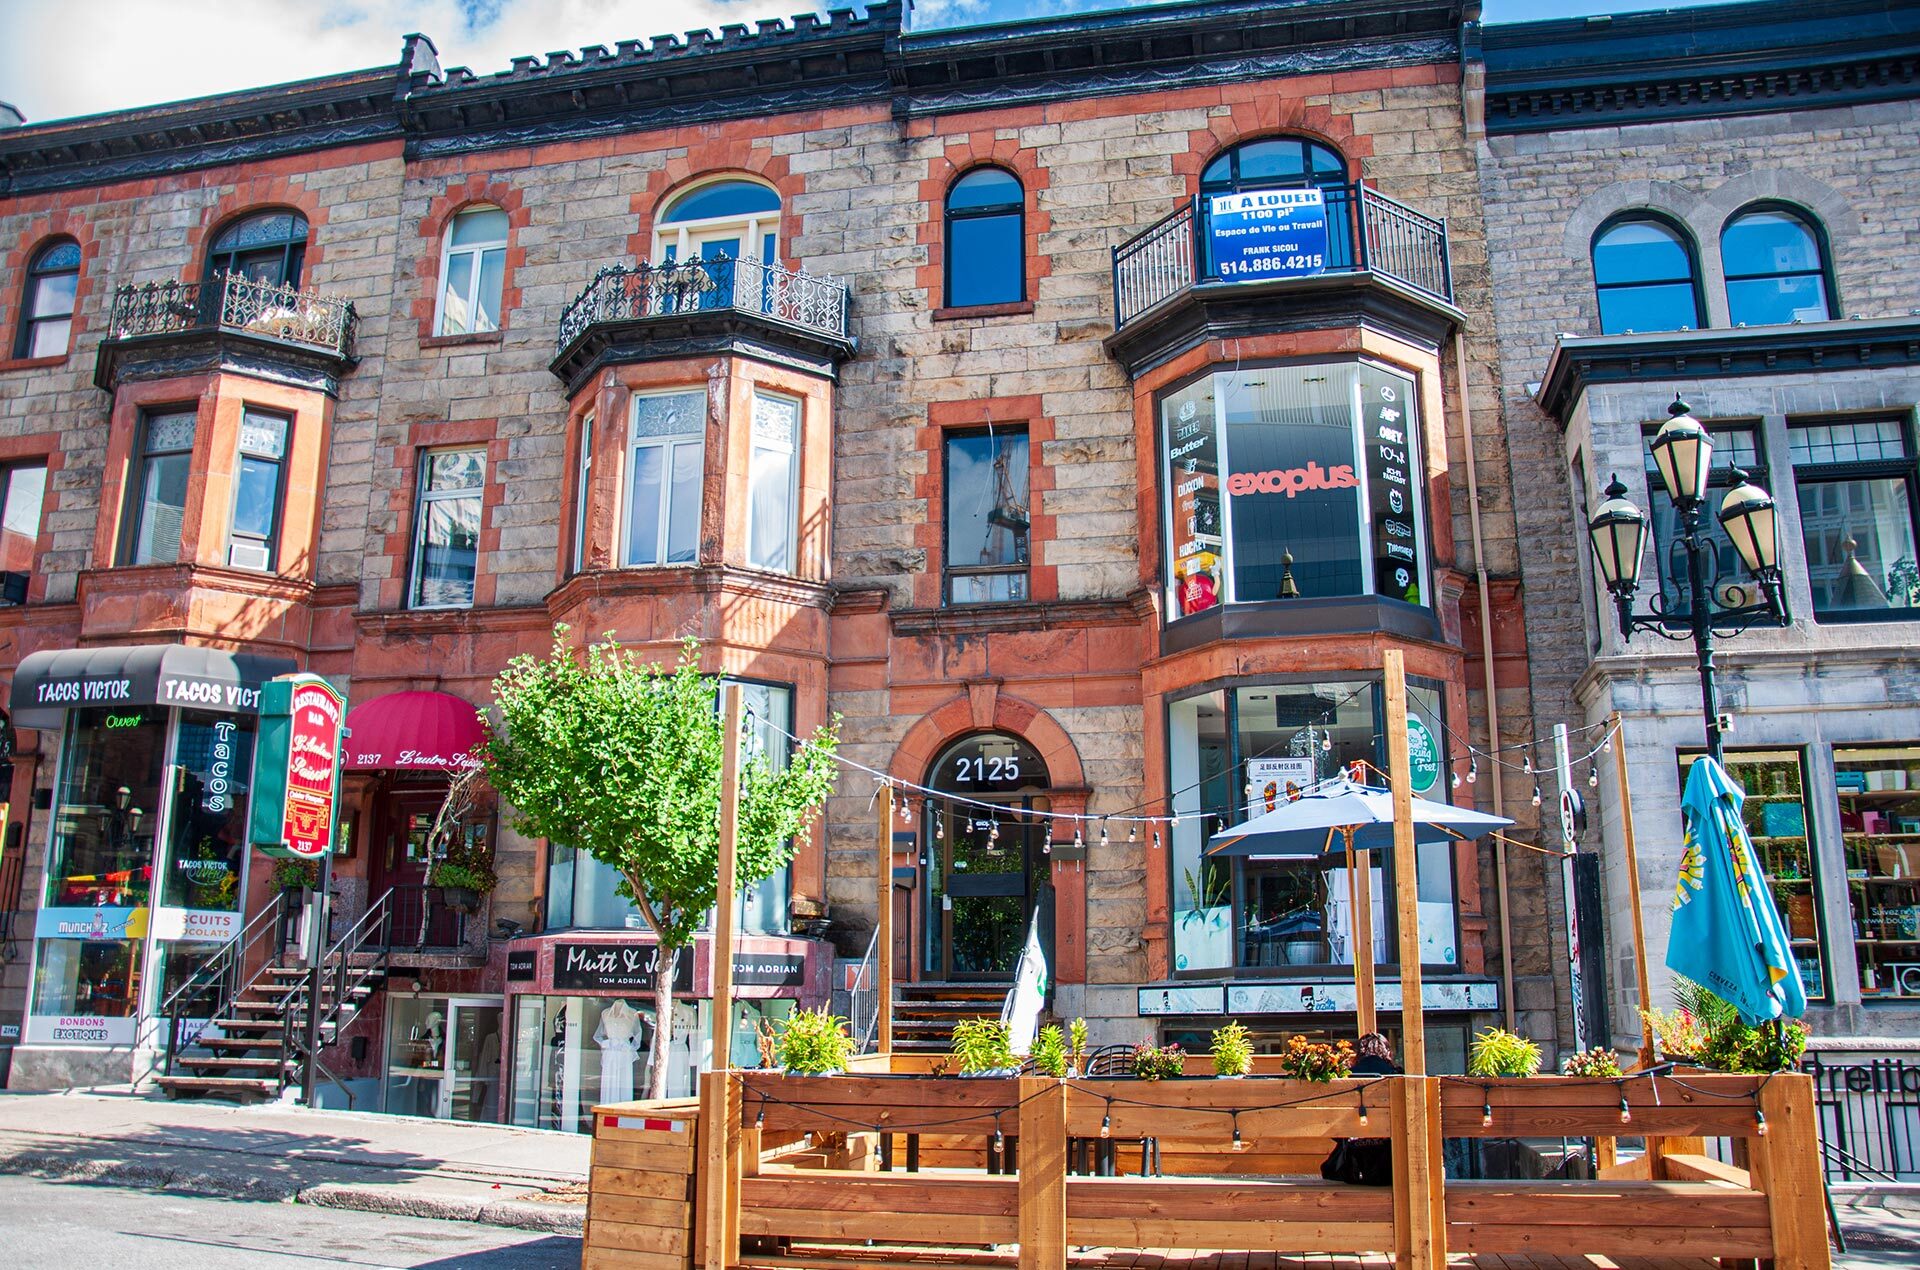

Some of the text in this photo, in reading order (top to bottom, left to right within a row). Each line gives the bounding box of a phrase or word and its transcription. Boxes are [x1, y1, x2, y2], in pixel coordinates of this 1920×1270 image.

[1258, 193, 1317, 206] LOUER
[1241, 210, 1273, 220] 1100
[1215, 226, 1247, 237] Espace
[1248, 226, 1260, 234] de
[1262, 224, 1277, 233] Vie
[1292, 219, 1323, 231] Travail
[1243, 243, 1299, 255] FRANK SICOLI
[1220, 254, 1323, 275] 514.886.4215
[1179, 536, 1207, 558] HOCKEY
[38, 679, 131, 703] TACOS VICTOR
[165, 679, 261, 708] TACOS VICT
[294, 690, 339, 724] RESTAURANT
[307, 710, 325, 727] BAR
[357, 753, 382, 765] 2137
[956, 756, 1029, 782] 2125
[297, 840, 313, 852] 2137
[177, 859, 229, 871] TACOS VICTOR
[182, 914, 231, 926] SCUITS
[566, 945, 618, 974] Mutt
[623, 948, 640, 973] &
[732, 964, 798, 974] TOM ADRIAN
[617, 977, 648, 985] ADRIAN
[1708, 970, 1738, 992] CERVEZA
[59, 1017, 105, 1027] BONBONS
[53, 1028, 109, 1041] EXOTIQUES
